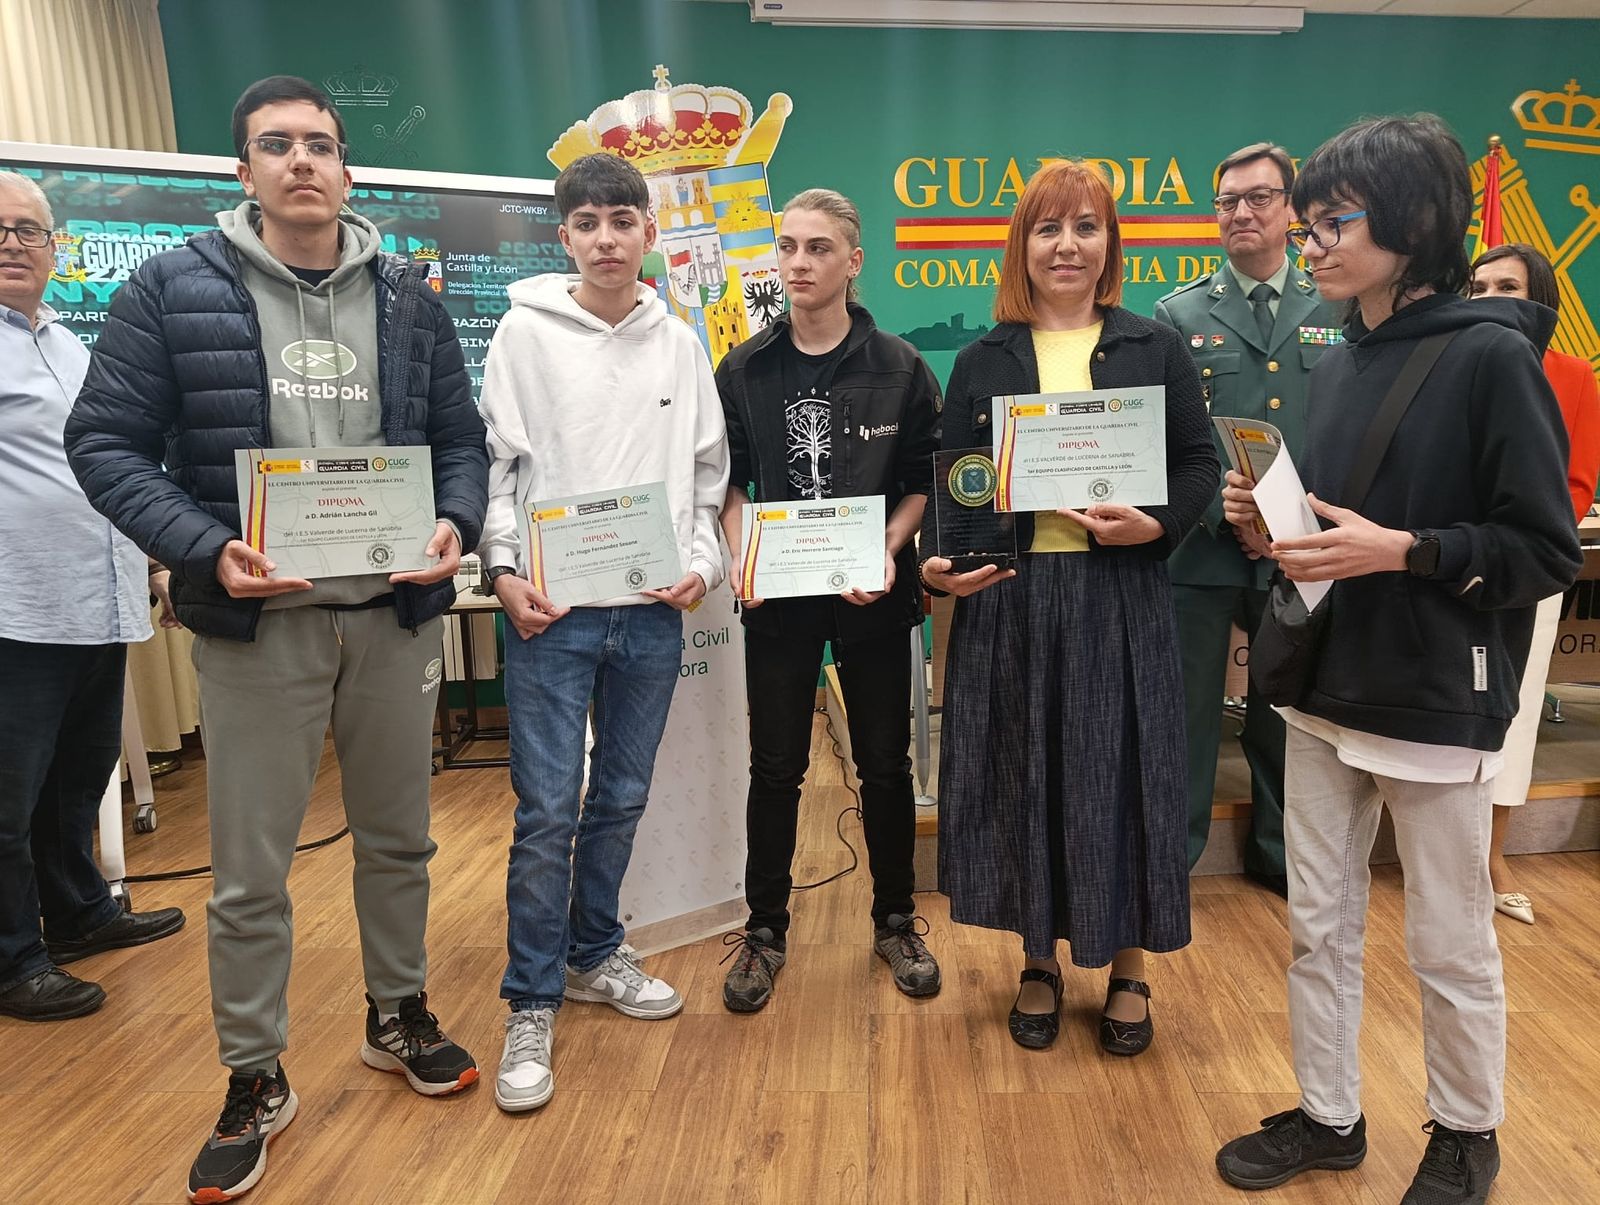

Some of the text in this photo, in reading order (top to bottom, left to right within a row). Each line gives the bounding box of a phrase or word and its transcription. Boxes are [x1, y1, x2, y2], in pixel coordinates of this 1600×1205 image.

[894, 157, 1194, 208] GUADIA
[500, 204, 547, 215] JCTC-WKBY
[446, 252, 490, 262] Junta de
[447, 263, 518, 274] Castilla y León
[272, 378, 368, 401] Reebok
[1058, 440, 1099, 450] DIPLOMA
[317, 497, 365, 507] DIPLOMA
[633, 494, 650, 502] CUGC
[582, 531, 619, 543] DIPLOMA
[796, 536, 831, 544] DIPLOMA
[577, 547, 590, 555] Hugo
[592, 543, 618, 552] Fernández
[693, 627, 729, 648] Civil
